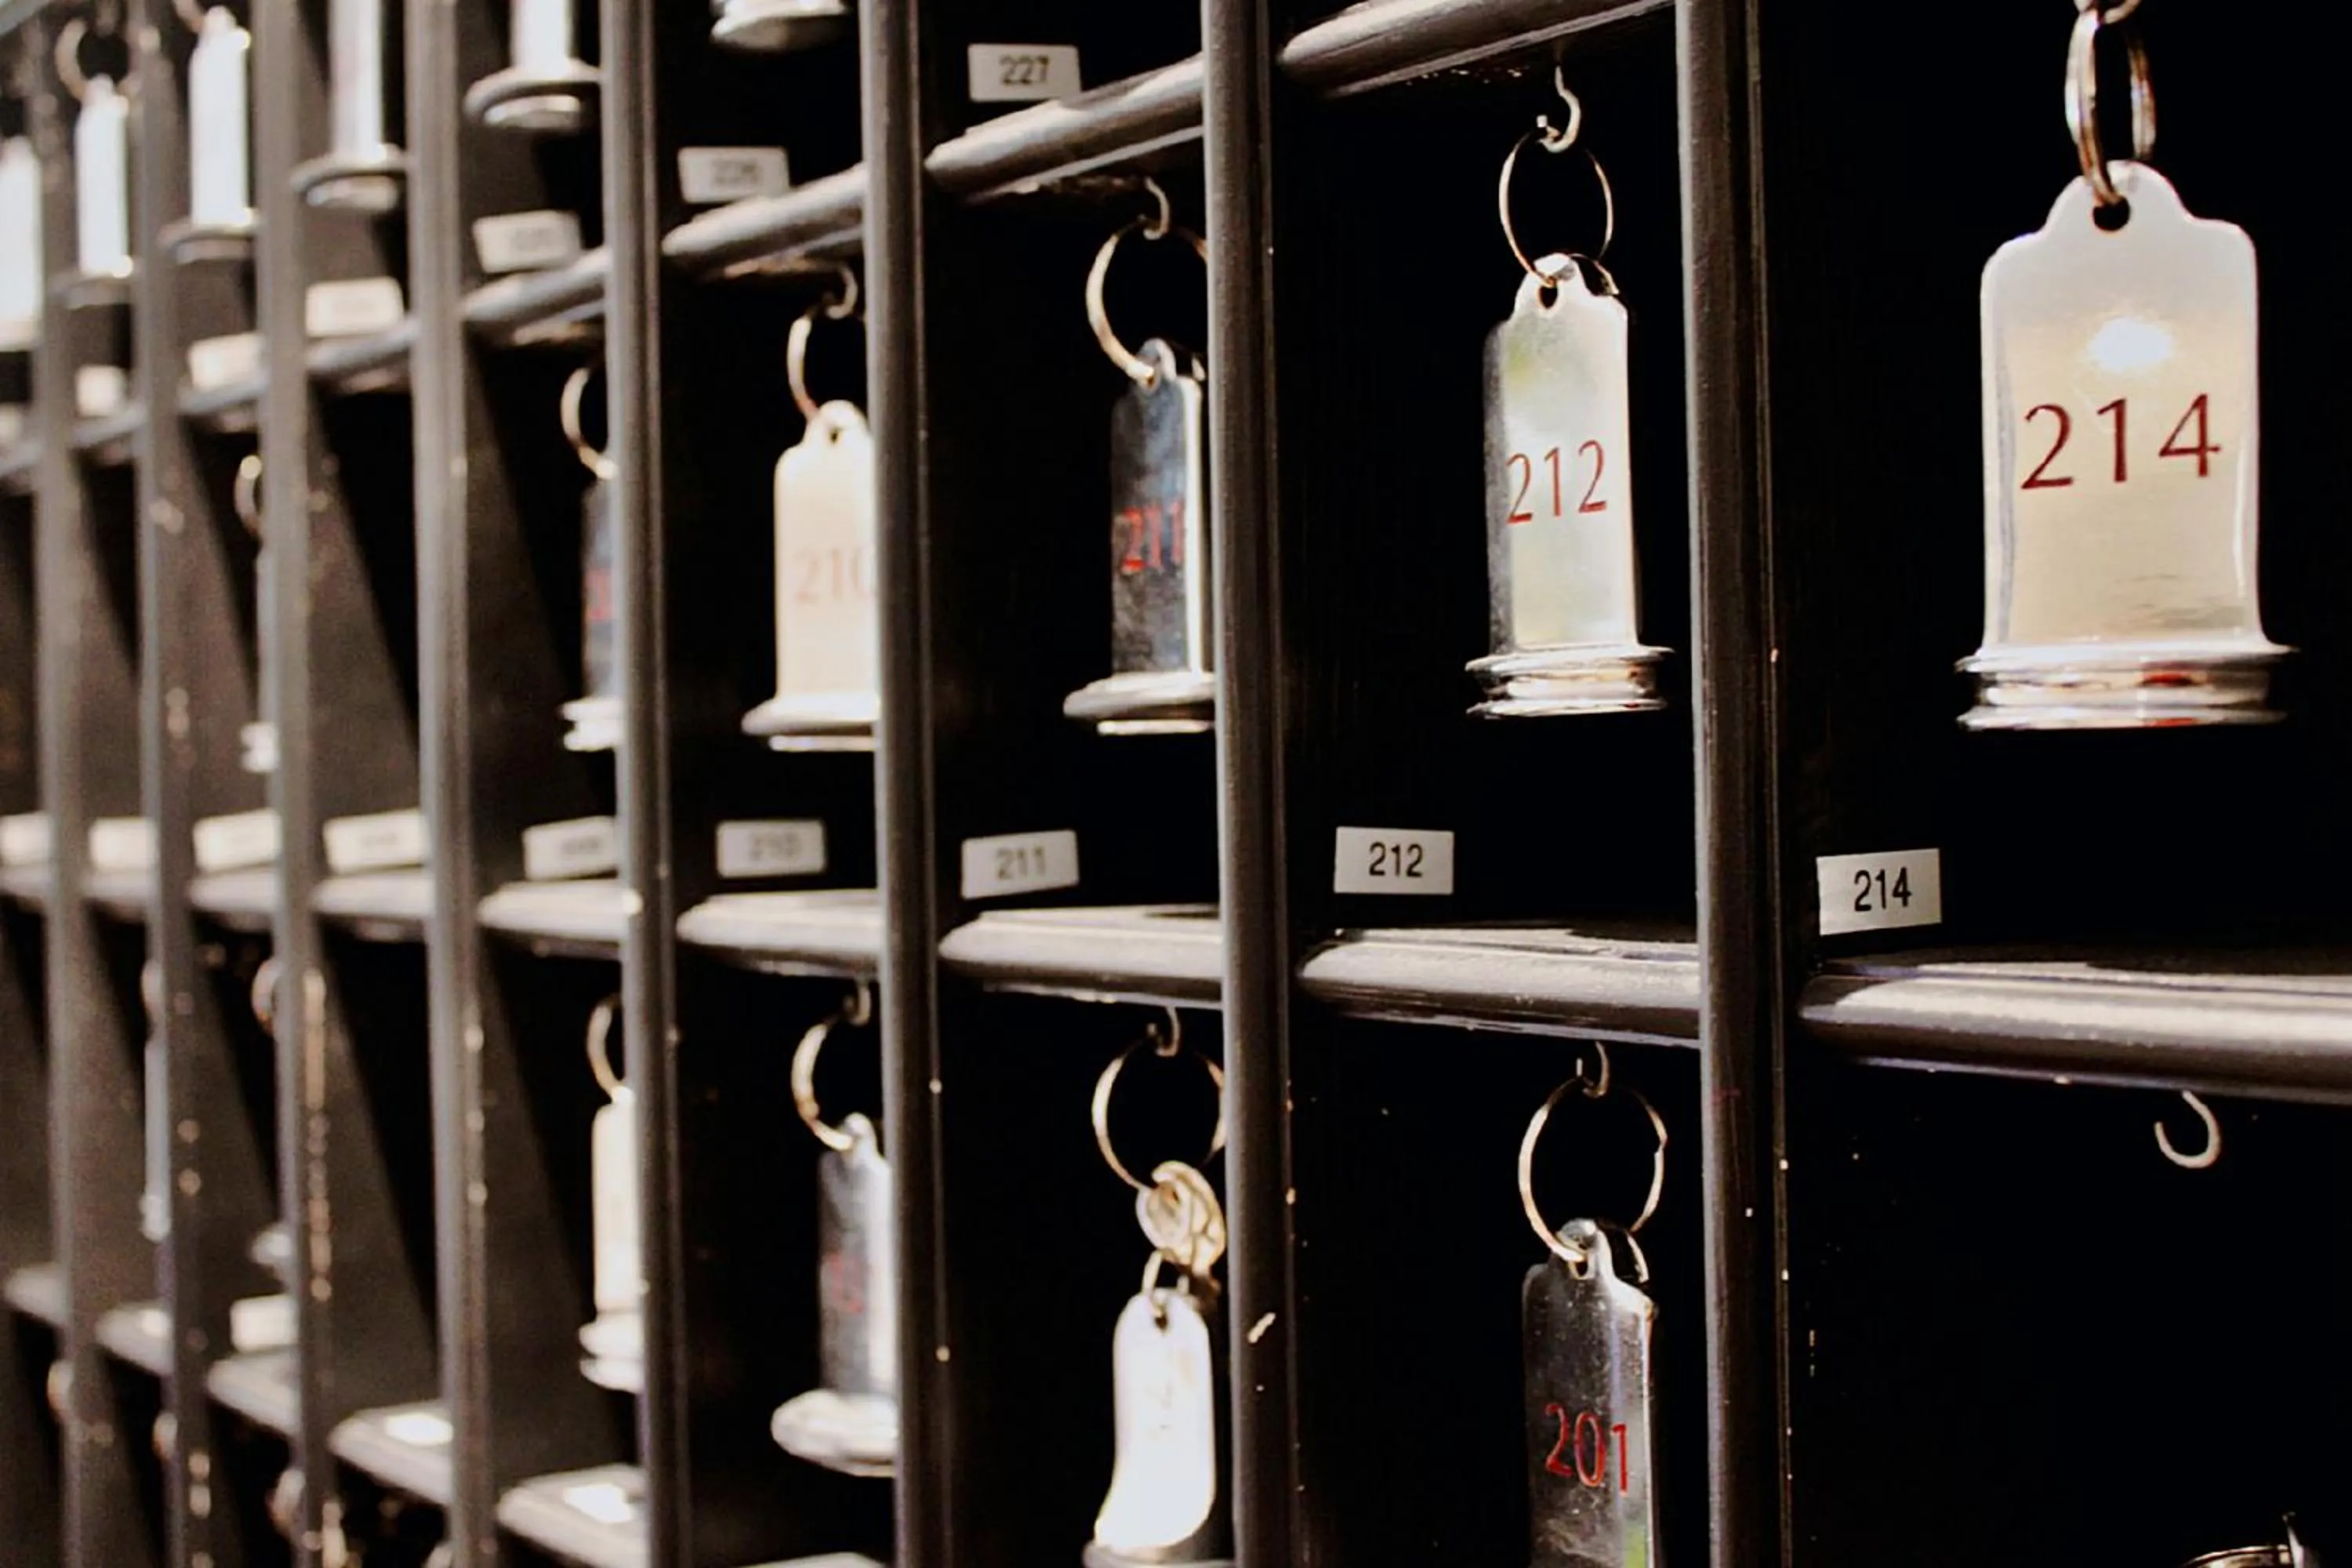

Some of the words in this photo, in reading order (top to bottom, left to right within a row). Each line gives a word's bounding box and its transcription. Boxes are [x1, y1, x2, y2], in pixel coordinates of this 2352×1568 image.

[1000, 55, 1050, 85] 227
[2020, 392, 2222, 490] 214
[1504, 438, 1607, 525] 212
[996, 845, 1047, 880] 211
[1368, 841, 1424, 878] 212
[1853, 865, 1913, 913] 214
[1544, 1402, 1628, 1498] 201
